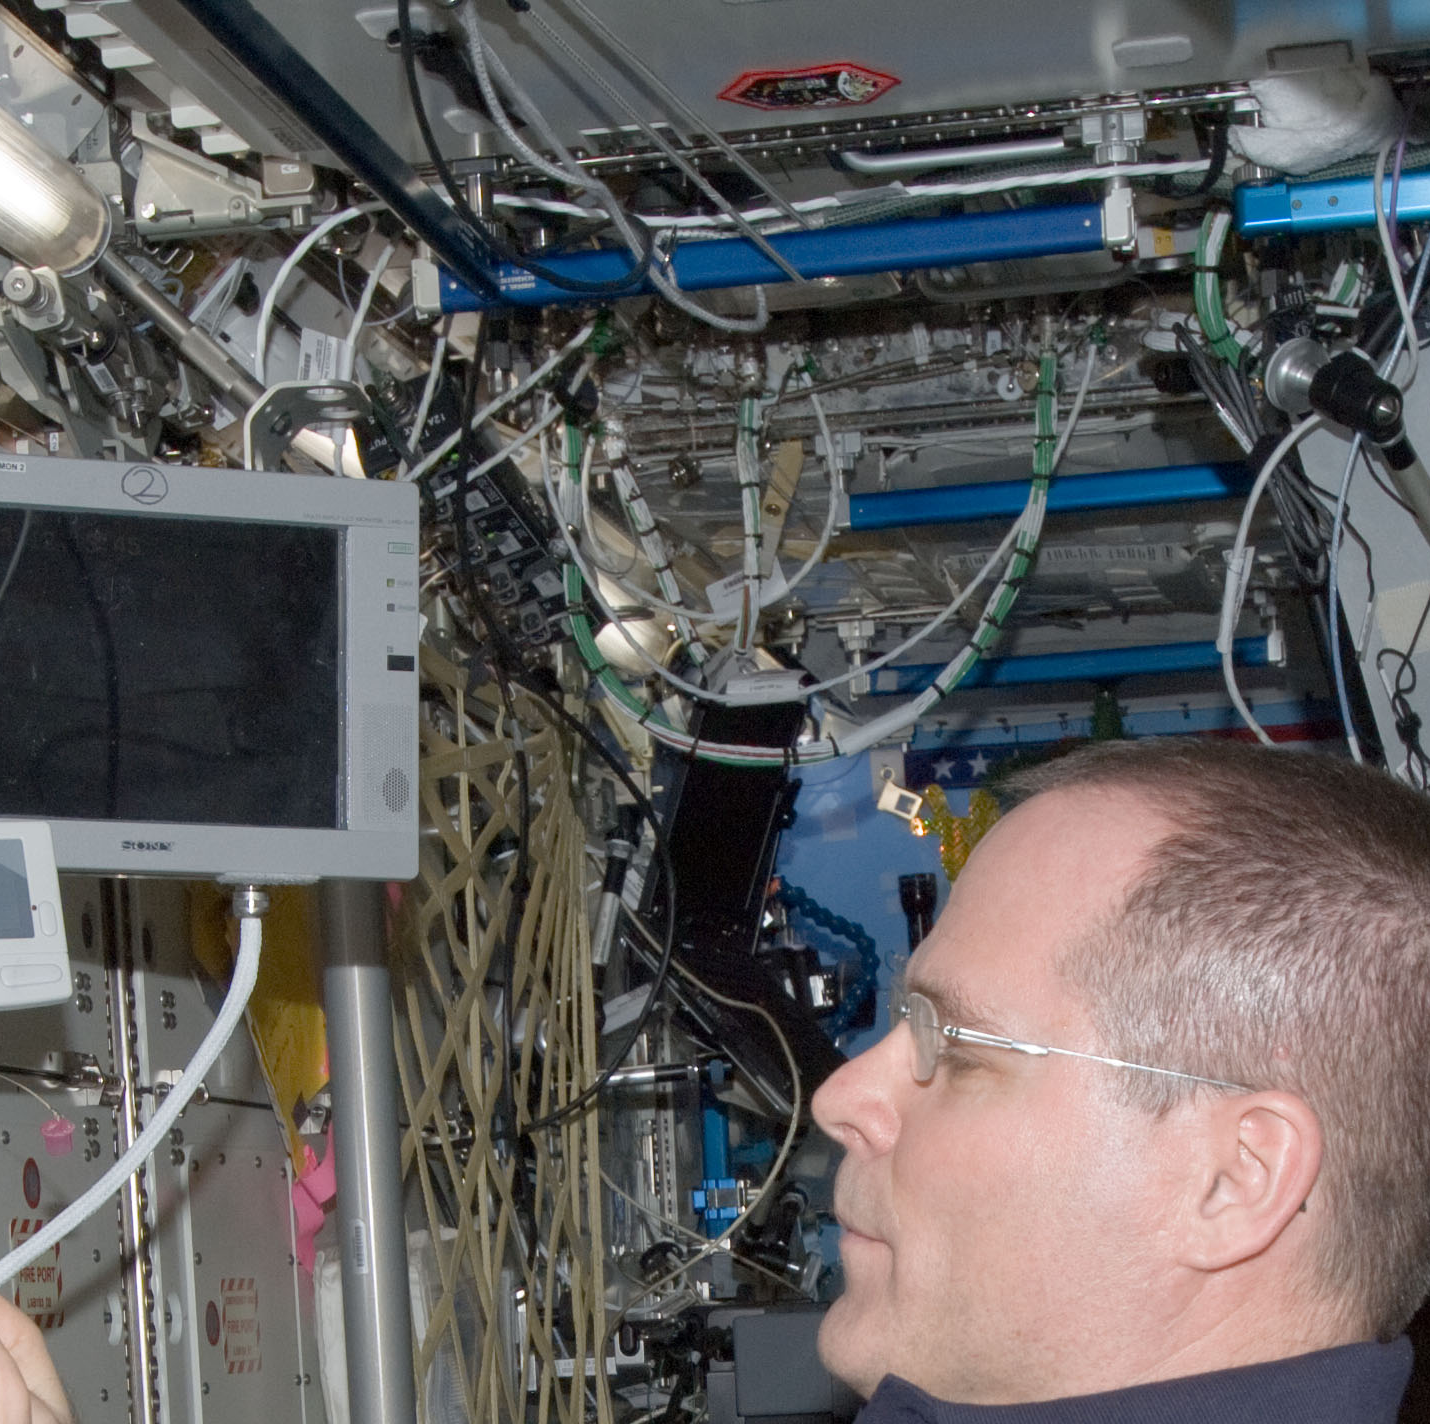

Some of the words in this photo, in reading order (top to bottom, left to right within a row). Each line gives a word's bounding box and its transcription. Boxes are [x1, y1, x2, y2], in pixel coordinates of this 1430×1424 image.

[19, 463, 25, 472] 2
[132, 468, 161, 498] 2
[121, 839, 173, 851] SONY
[20, 1267, 35, 1283] FIRE
[37, 1267, 56, 1283] PORT
